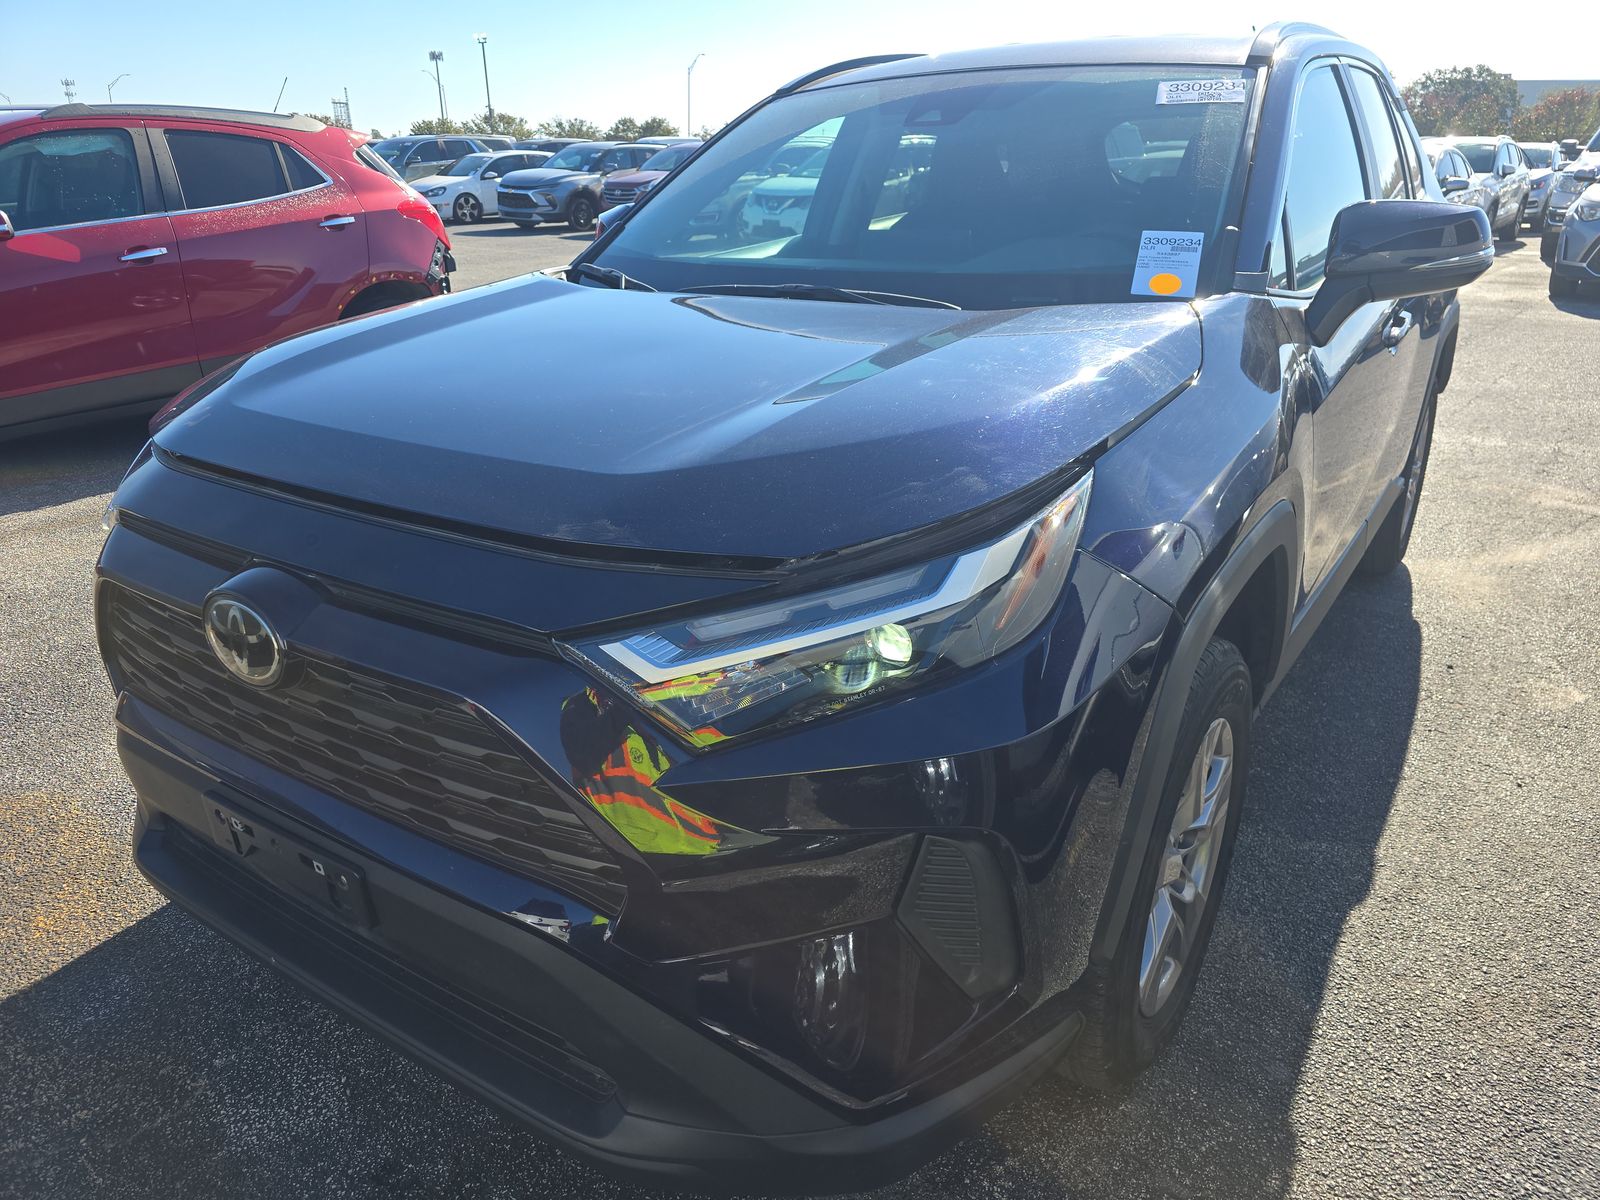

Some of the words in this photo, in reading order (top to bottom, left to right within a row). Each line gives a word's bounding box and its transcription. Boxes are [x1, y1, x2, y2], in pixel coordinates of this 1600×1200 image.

[1169, 81, 1246, 92] 3309234
[1143, 237, 1202, 247] 3309234
[843, 691, 867, 703] STANLEY
